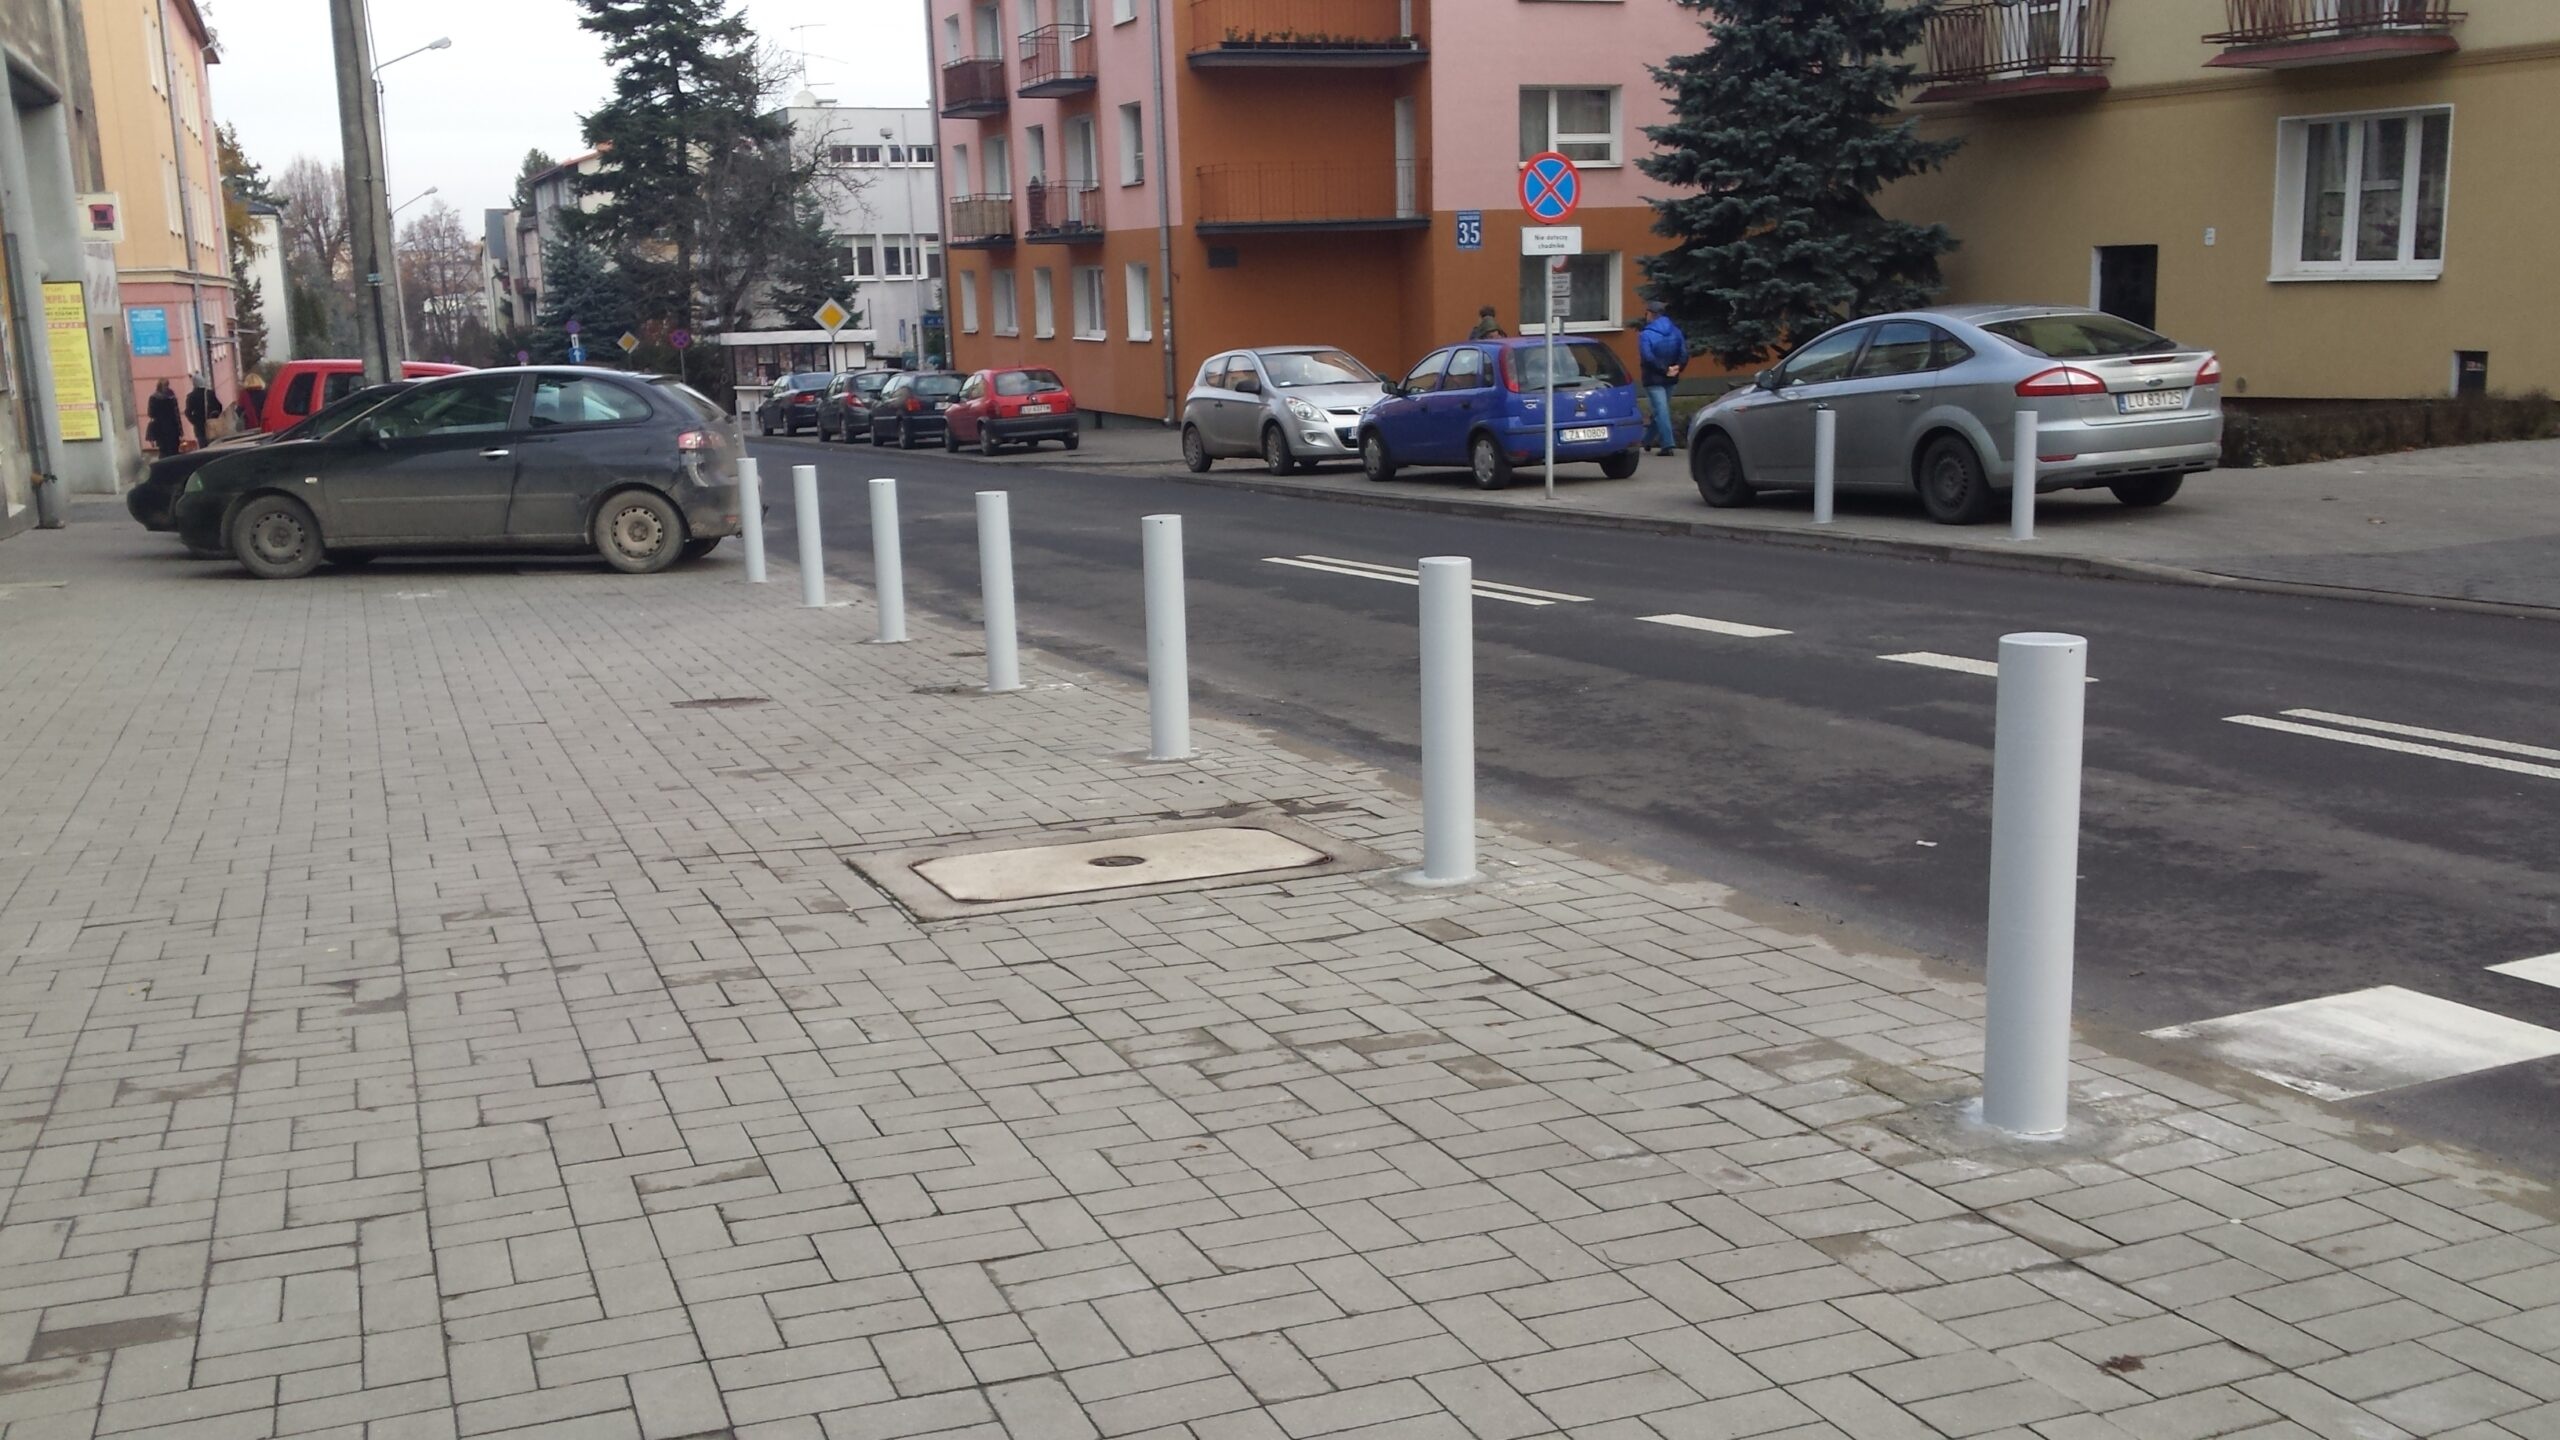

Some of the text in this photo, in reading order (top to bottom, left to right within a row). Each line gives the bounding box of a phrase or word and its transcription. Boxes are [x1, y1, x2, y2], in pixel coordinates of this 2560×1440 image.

[1458, 221, 1481, 244] 35
[2127, 391, 2182, 408] LU 8312S
[1564, 428, 1606, 441] LZA 10809
